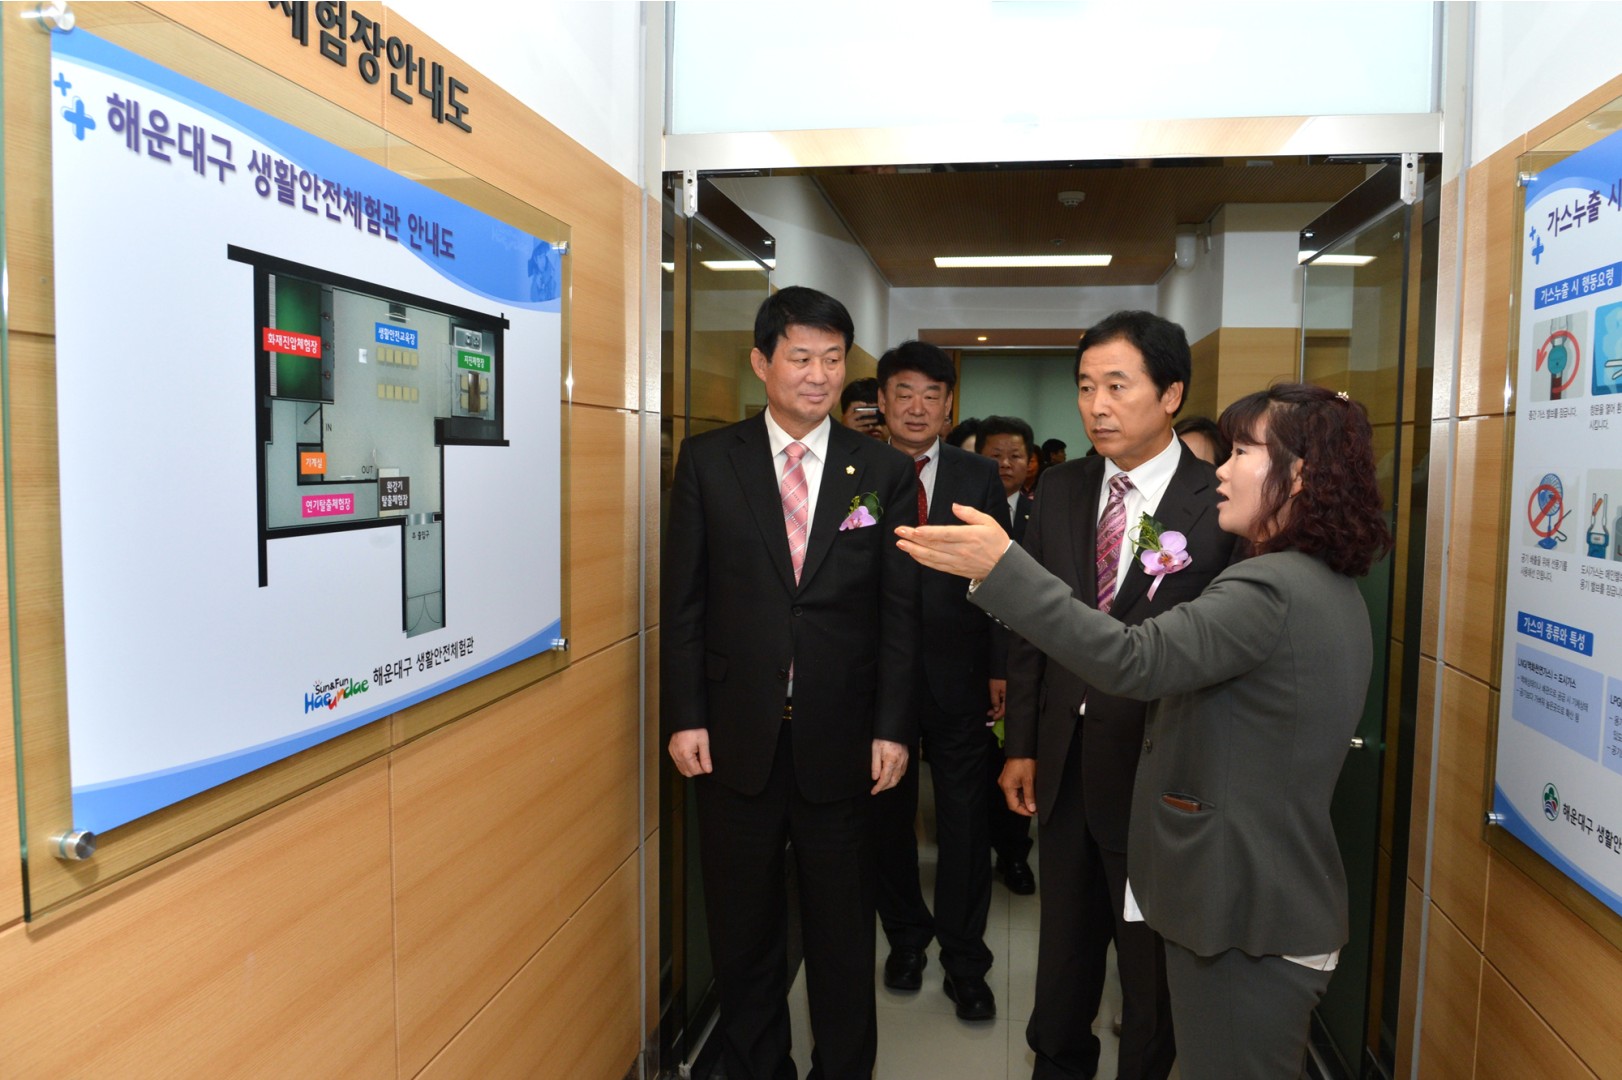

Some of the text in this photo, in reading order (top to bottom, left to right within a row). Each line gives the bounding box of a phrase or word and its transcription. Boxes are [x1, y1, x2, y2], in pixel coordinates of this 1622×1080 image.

[106, 92, 456, 259] 해운대구 생활안전체험관 안내도
[1547, 178, 1622, 238] 가스누출 시
[1541, 267, 1615, 305] 가스누출 시 행동요령
[267, 332, 318, 355] 화재진압체험장
[378, 326, 416, 346] 생활안전교육장
[325, 423, 332, 431] IN
[305, 457, 323, 469] 기계실
[361, 465, 373, 474] OUT
[386, 480, 403, 493] 완강기
[305, 497, 351, 513] 연기탈출체험장
[381, 494, 409, 507] 탈출체험장
[418, 530, 430, 541] 출입구
[1523, 617, 1586, 651] 가스의 종류와 특성
[373, 636, 474, 687] 해운대구 생활안전체험관
[304, 678, 370, 714] Haeundae
[314, 677, 349, 695] Sun&Fun
[1563, 803, 1594, 836] 해운대구
